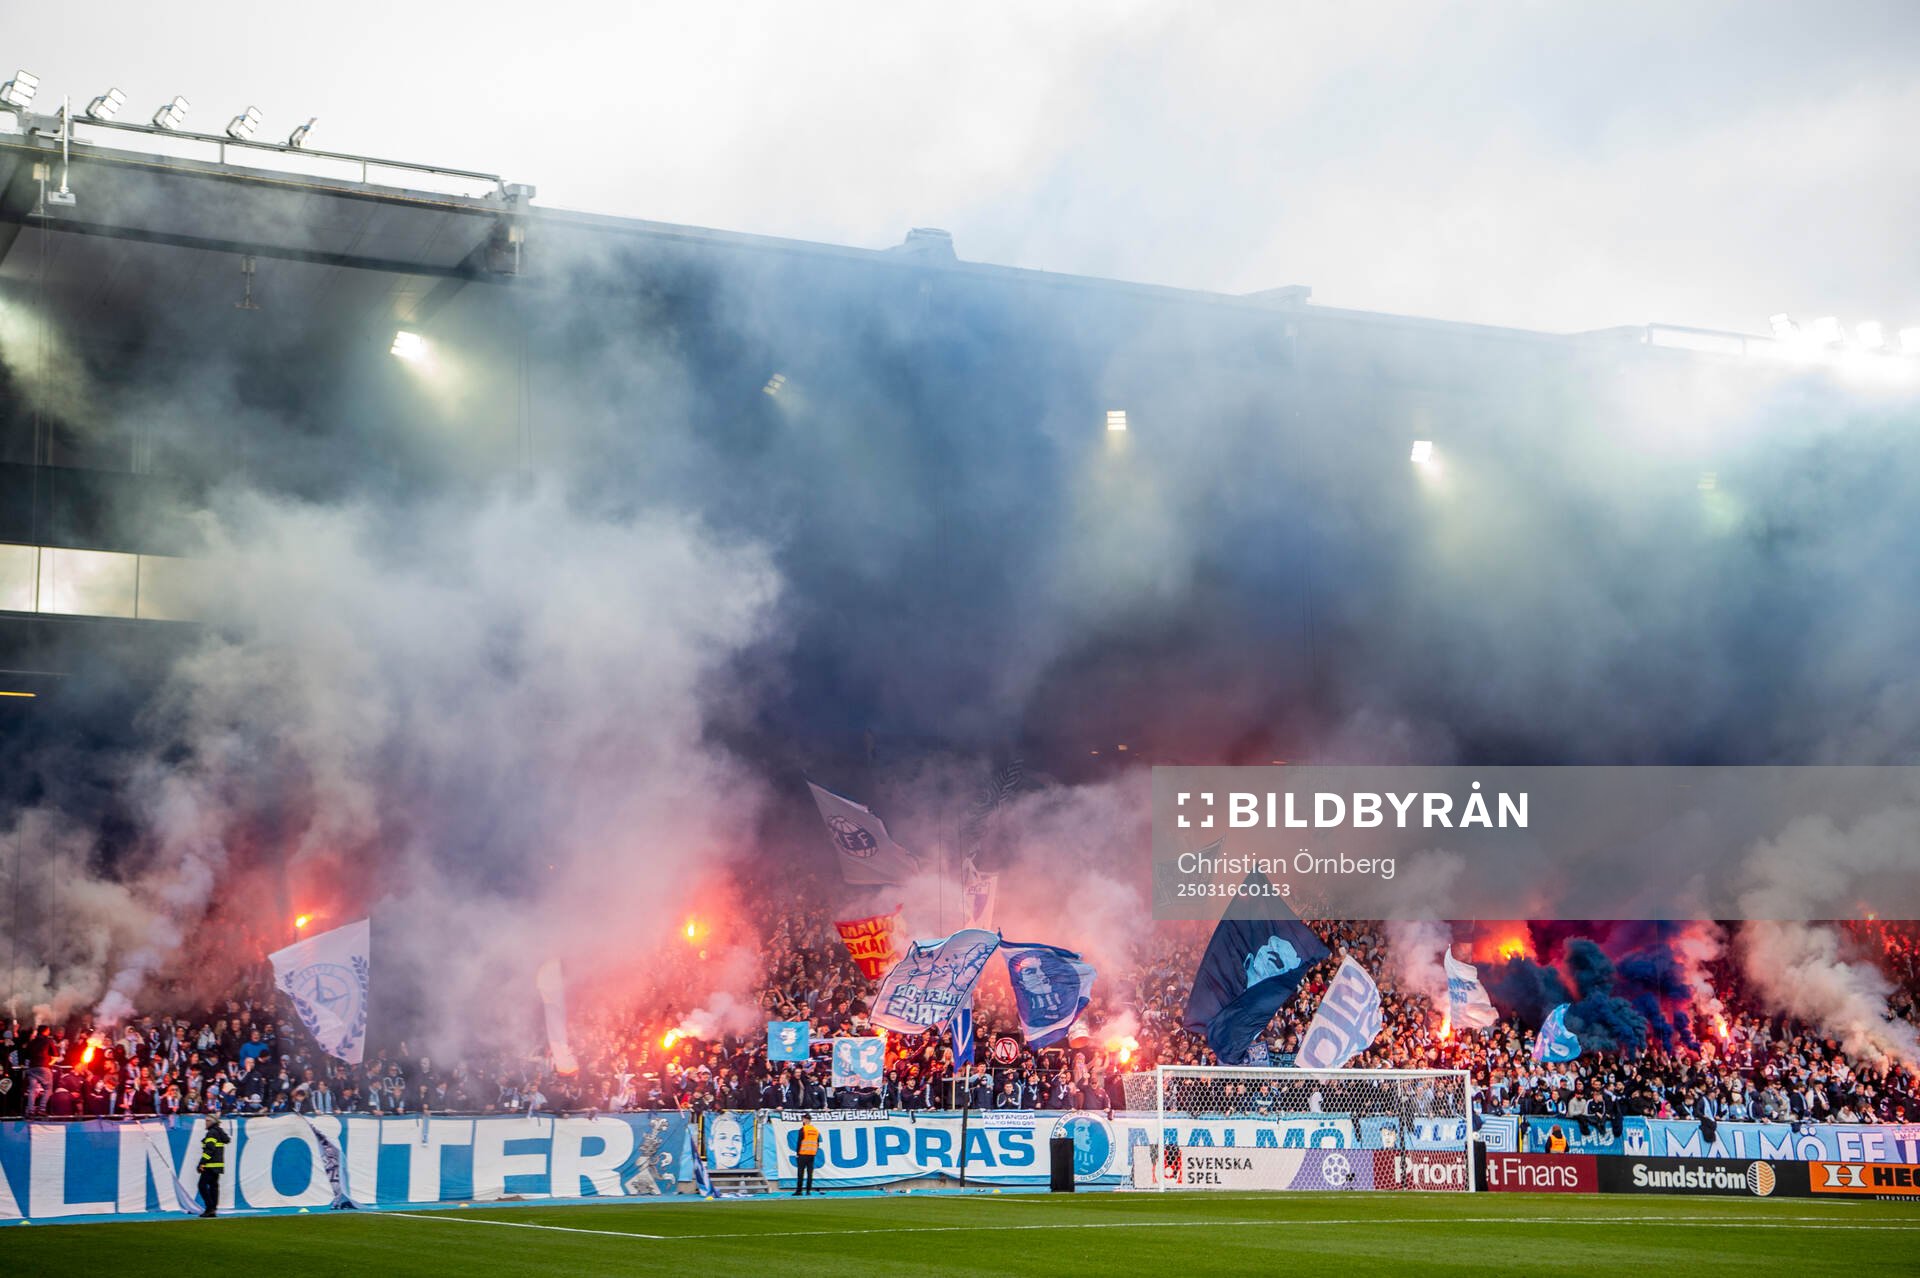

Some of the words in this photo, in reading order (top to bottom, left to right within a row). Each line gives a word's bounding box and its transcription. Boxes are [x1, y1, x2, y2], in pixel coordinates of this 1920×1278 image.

[1187, 1156, 1253, 1171] SVENSKA
[1502, 1158, 1579, 1188] Finans
[1187, 1171, 1222, 1185] SPEL
[1632, 1163, 1747, 1189] Sundström
